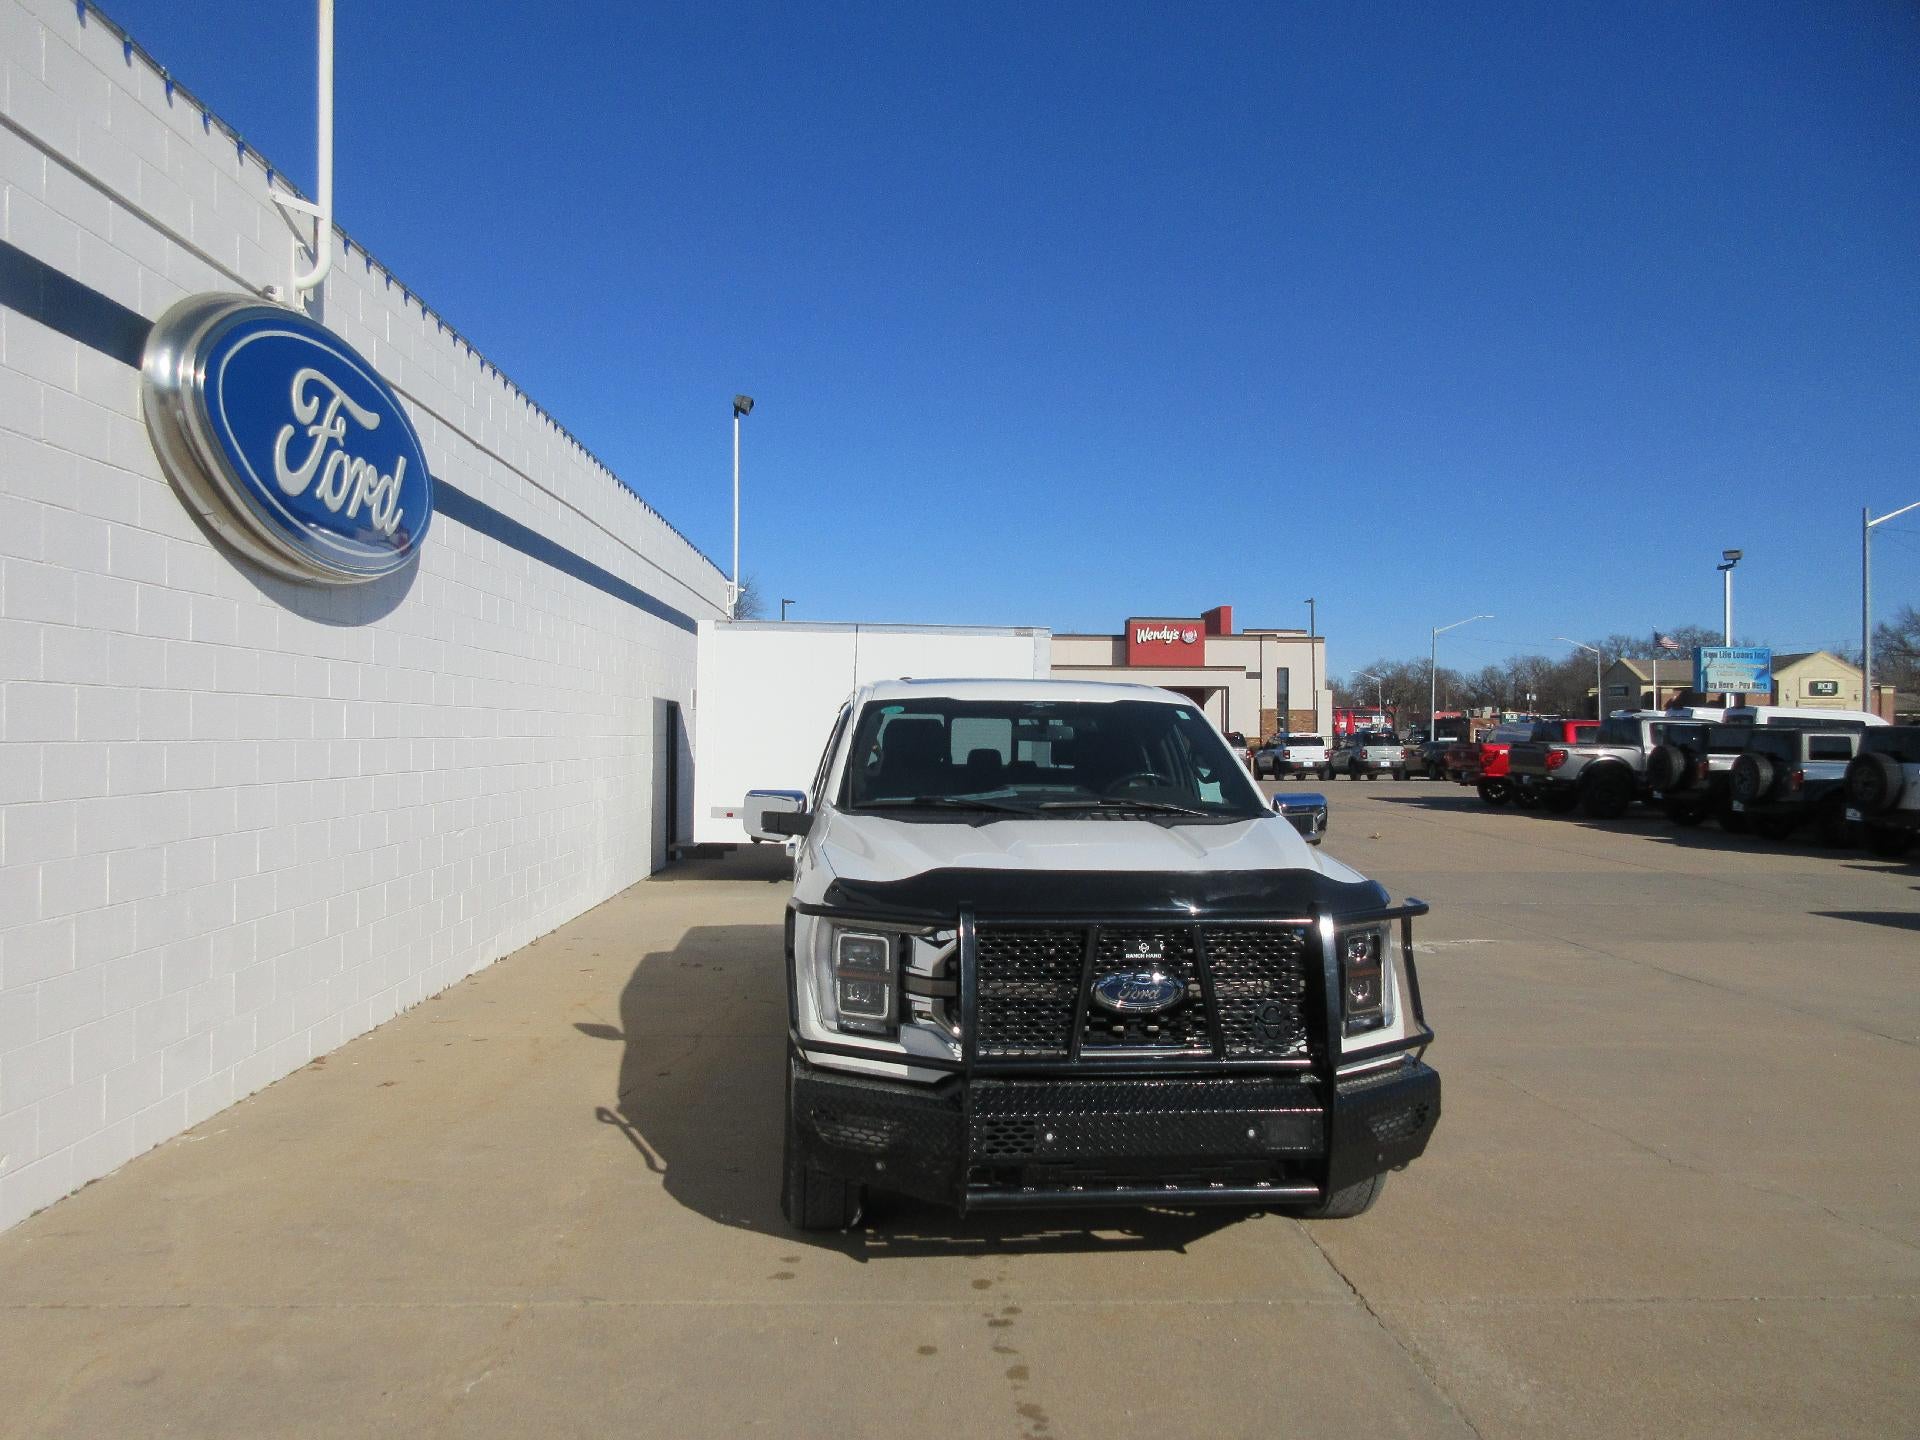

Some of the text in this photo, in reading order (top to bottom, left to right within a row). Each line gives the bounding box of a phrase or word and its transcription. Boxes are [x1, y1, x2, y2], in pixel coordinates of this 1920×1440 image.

[274, 368, 406, 536] Ford
[1136, 626, 1179, 643] Wendy's
[1739, 681, 1750, 689] Pay
[1118, 980, 1160, 1000] Ford
